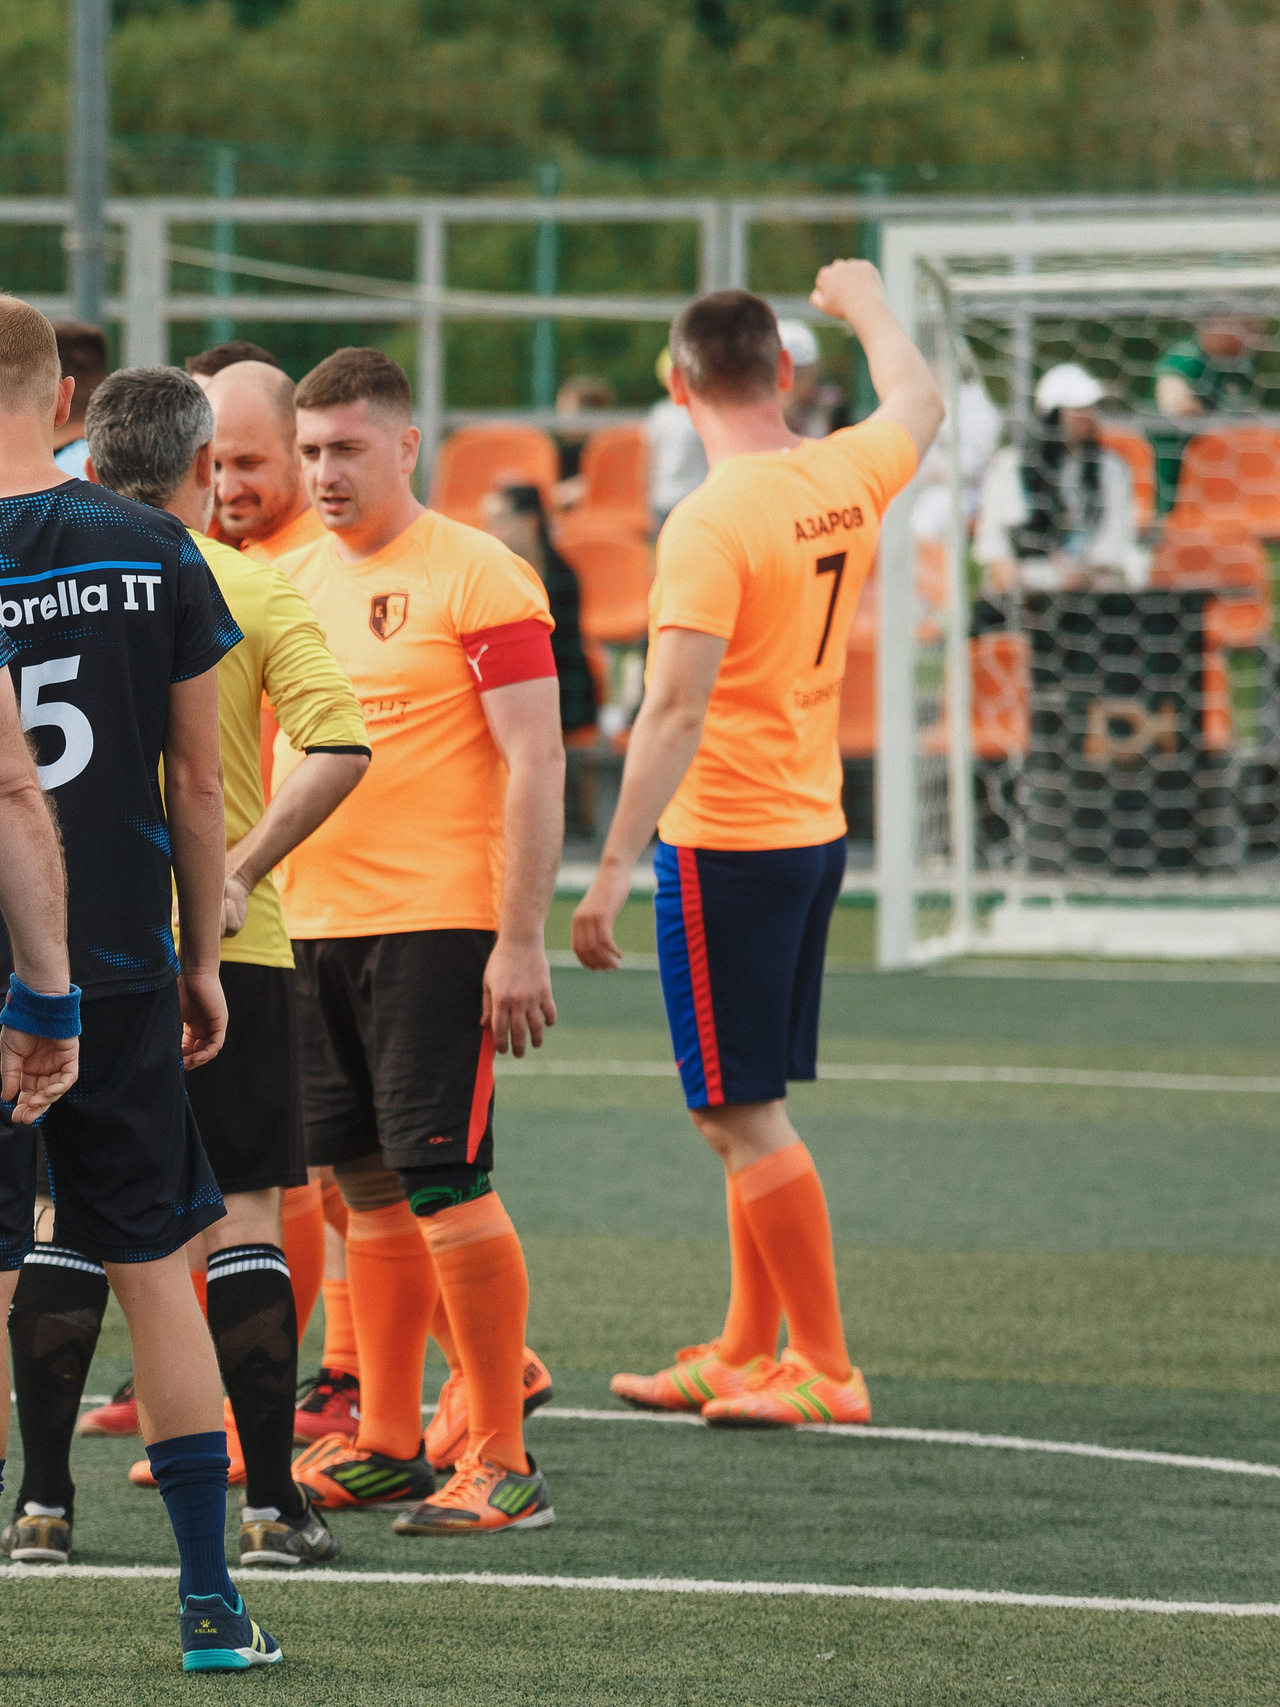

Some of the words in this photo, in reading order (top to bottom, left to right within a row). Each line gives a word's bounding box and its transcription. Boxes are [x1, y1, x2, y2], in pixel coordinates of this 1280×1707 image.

[794, 506, 864, 543] АЗАРОВ
[121, 574, 162, 611] IT
[814, 551, 847, 667] 7
[20, 655, 94, 791] 5
